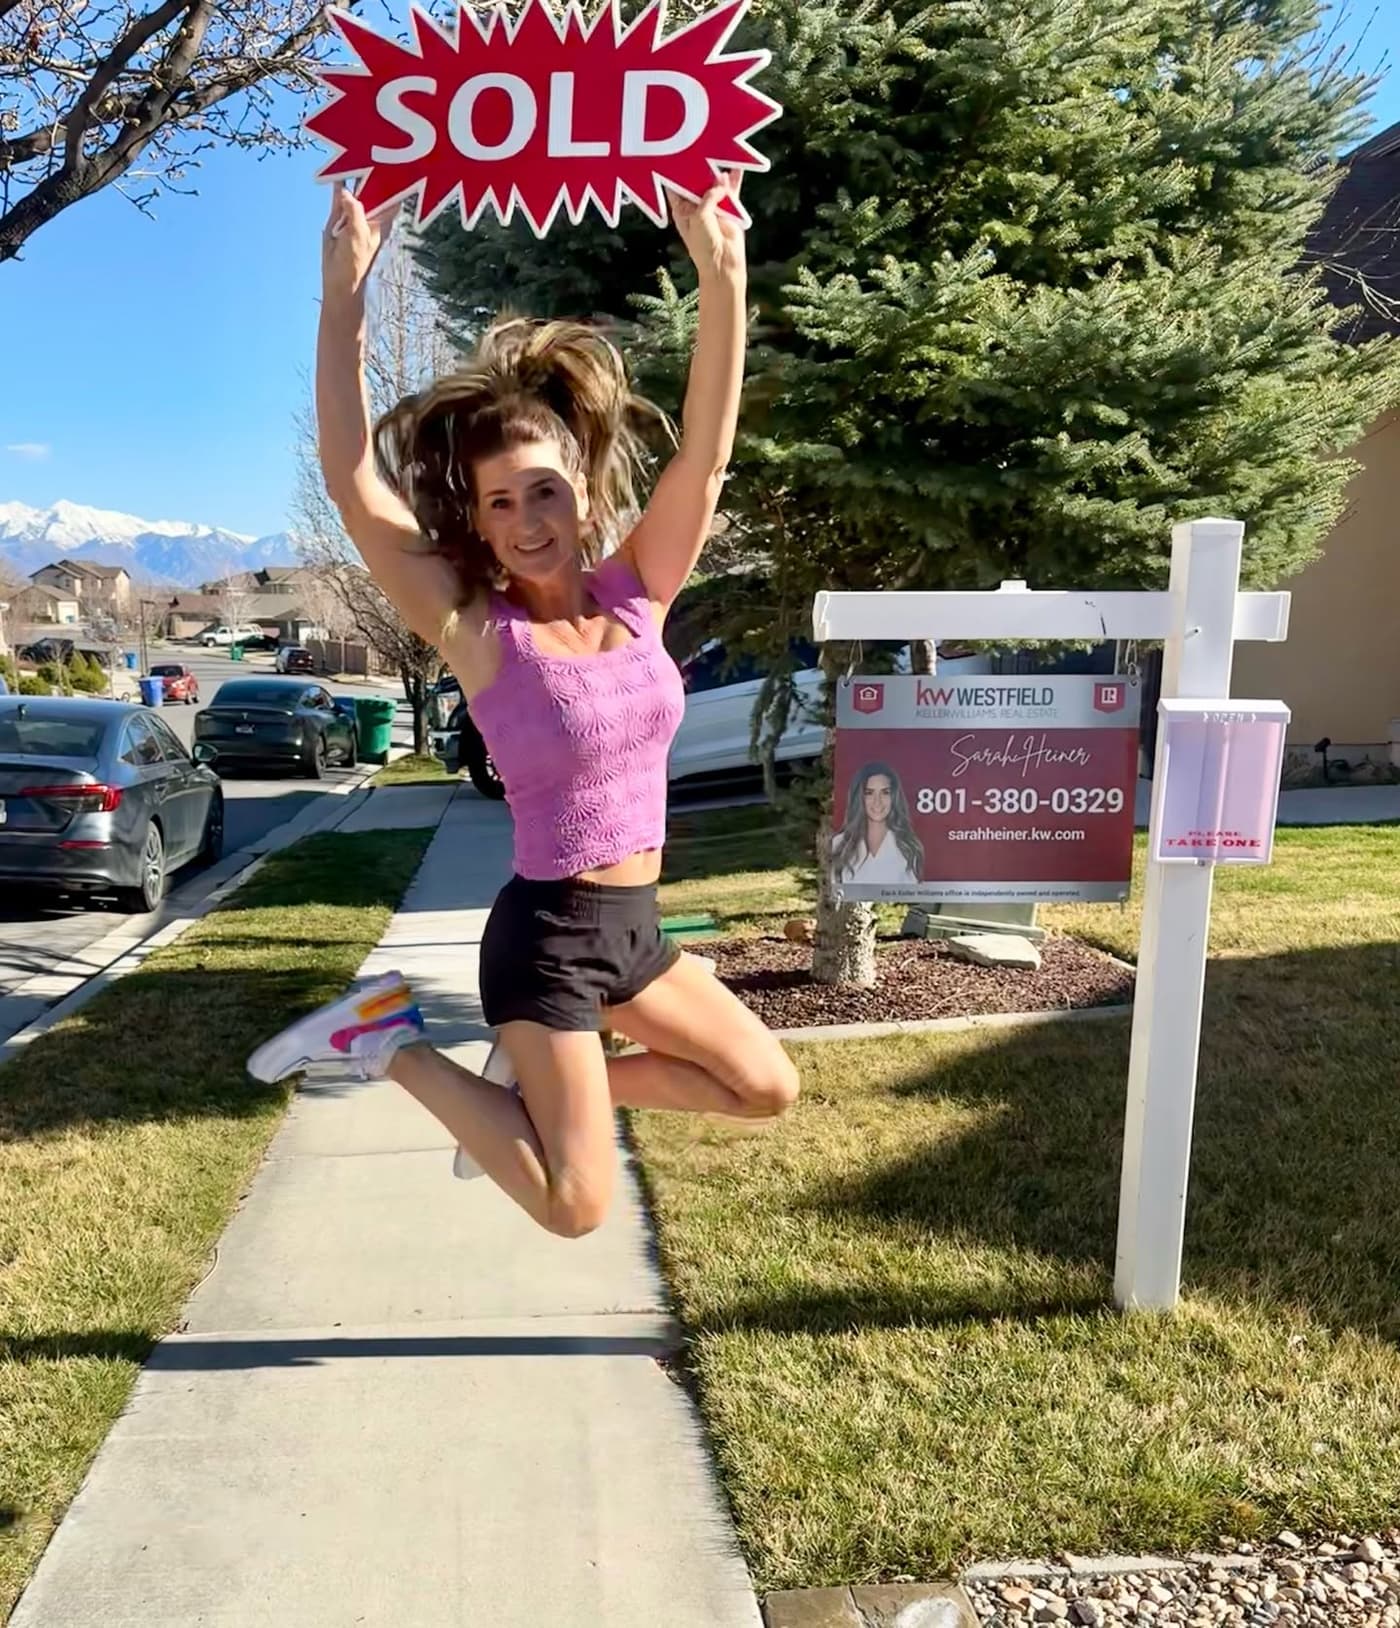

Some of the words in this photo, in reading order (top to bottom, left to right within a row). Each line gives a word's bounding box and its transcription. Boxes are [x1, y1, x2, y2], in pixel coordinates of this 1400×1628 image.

[371, 70, 710, 164] SOLD
[916, 680, 955, 706] kw
[956, 687, 1054, 706] WESTFIELD
[950, 734, 1017, 777] Sarah
[1012, 733, 1091, 777] Heiner
[916, 788, 1125, 814] 801-380-0329
[948, 827, 1085, 841] sarahheiner.kw.com
[1167, 839, 1217, 847] TAKE
[1222, 839, 1261, 847] ONE
